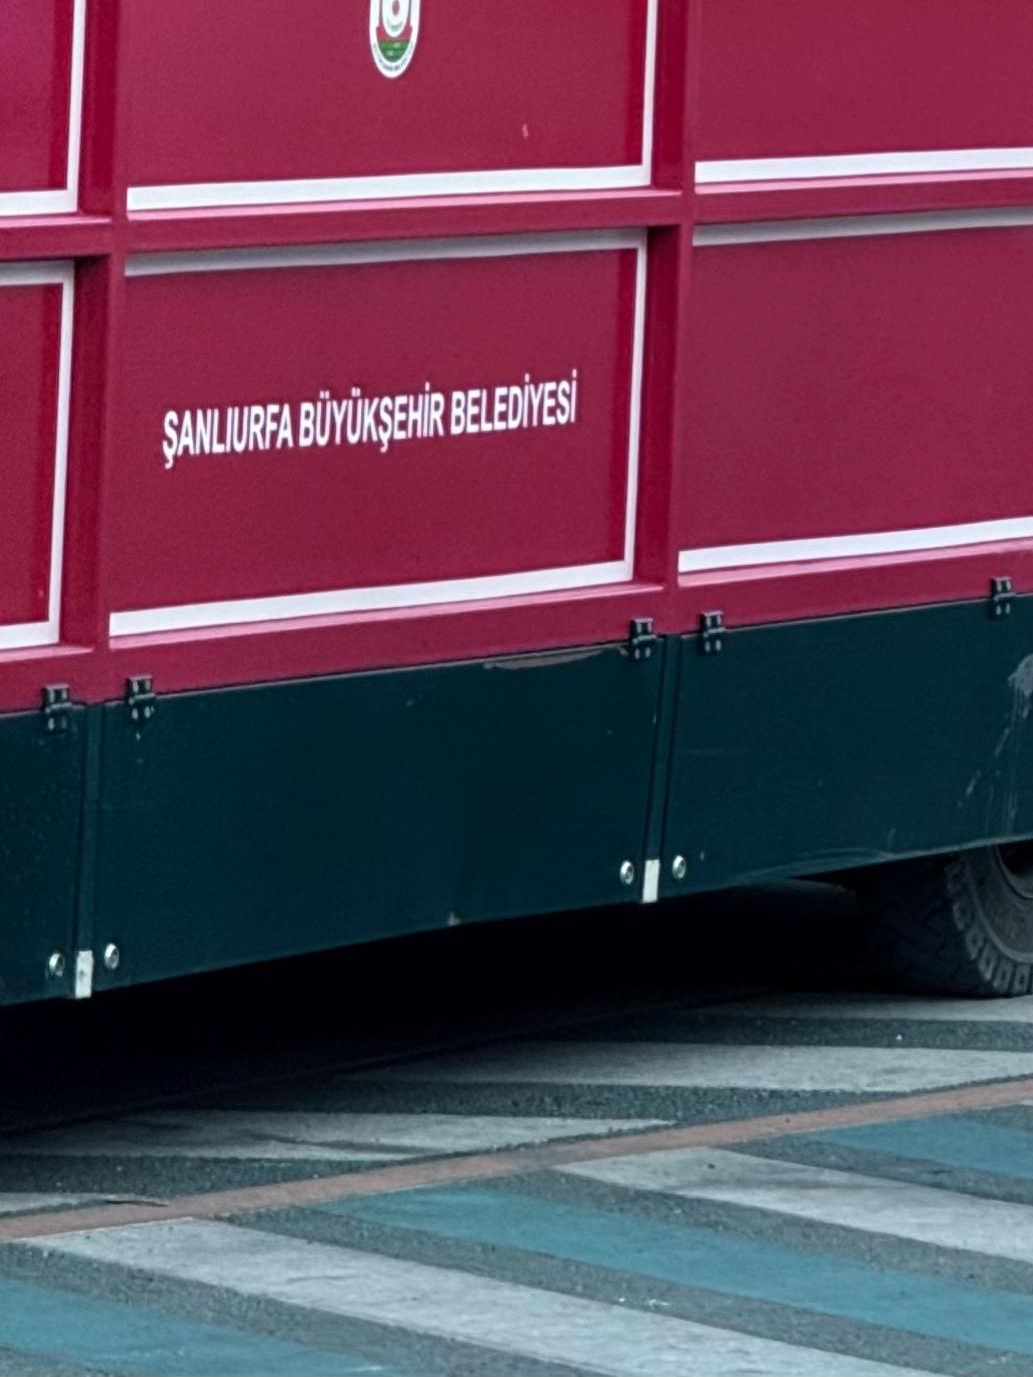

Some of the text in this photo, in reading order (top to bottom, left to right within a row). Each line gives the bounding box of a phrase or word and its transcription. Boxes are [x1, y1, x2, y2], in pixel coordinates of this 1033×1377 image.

[162, 368, 578, 470] ŞANLIURFA BÜYÜKŞEHİR BELEDİYESİ
